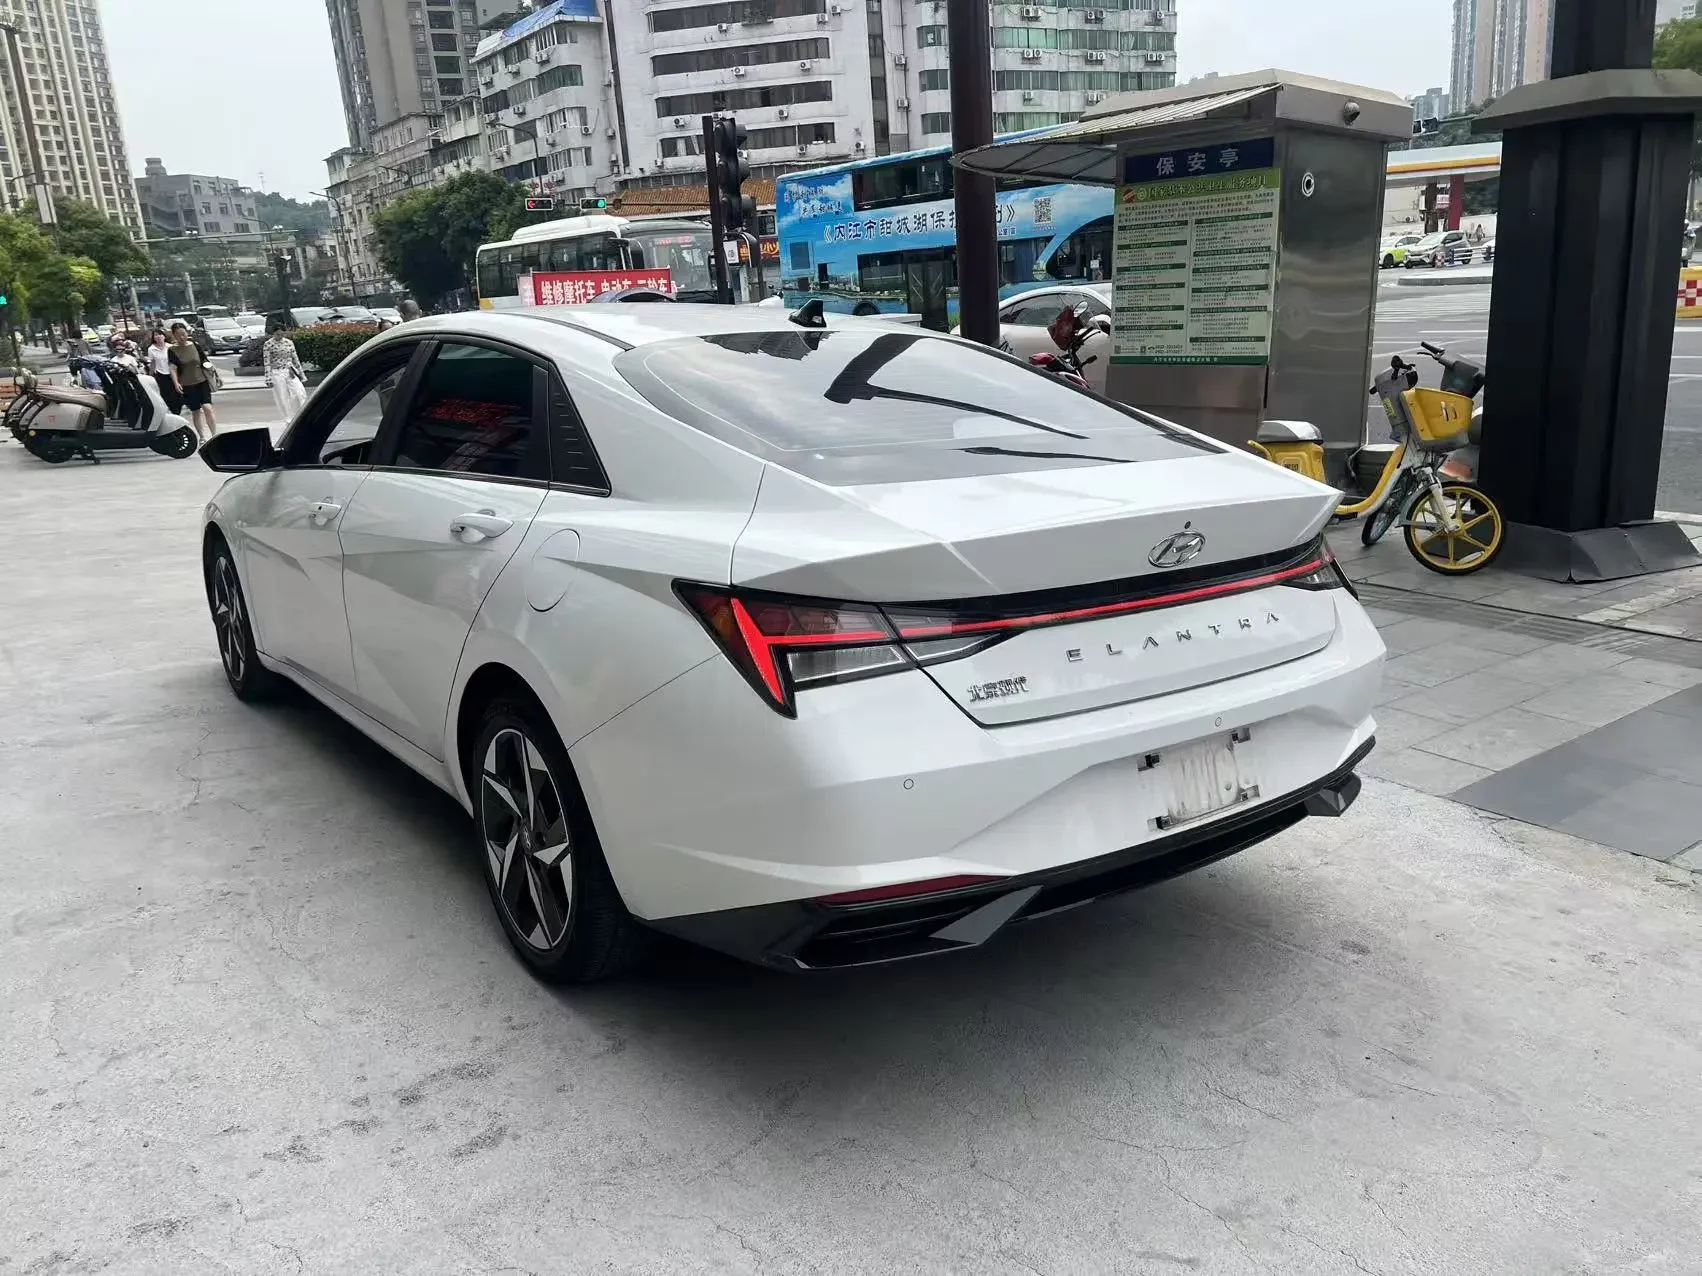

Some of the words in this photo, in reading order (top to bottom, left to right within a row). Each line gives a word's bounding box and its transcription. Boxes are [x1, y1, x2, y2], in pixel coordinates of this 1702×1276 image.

[1156, 147, 1239, 176] 保安亭
[1065, 612, 1280, 663] ELANTRA
[967, 676, 1029, 703] 北京现代
